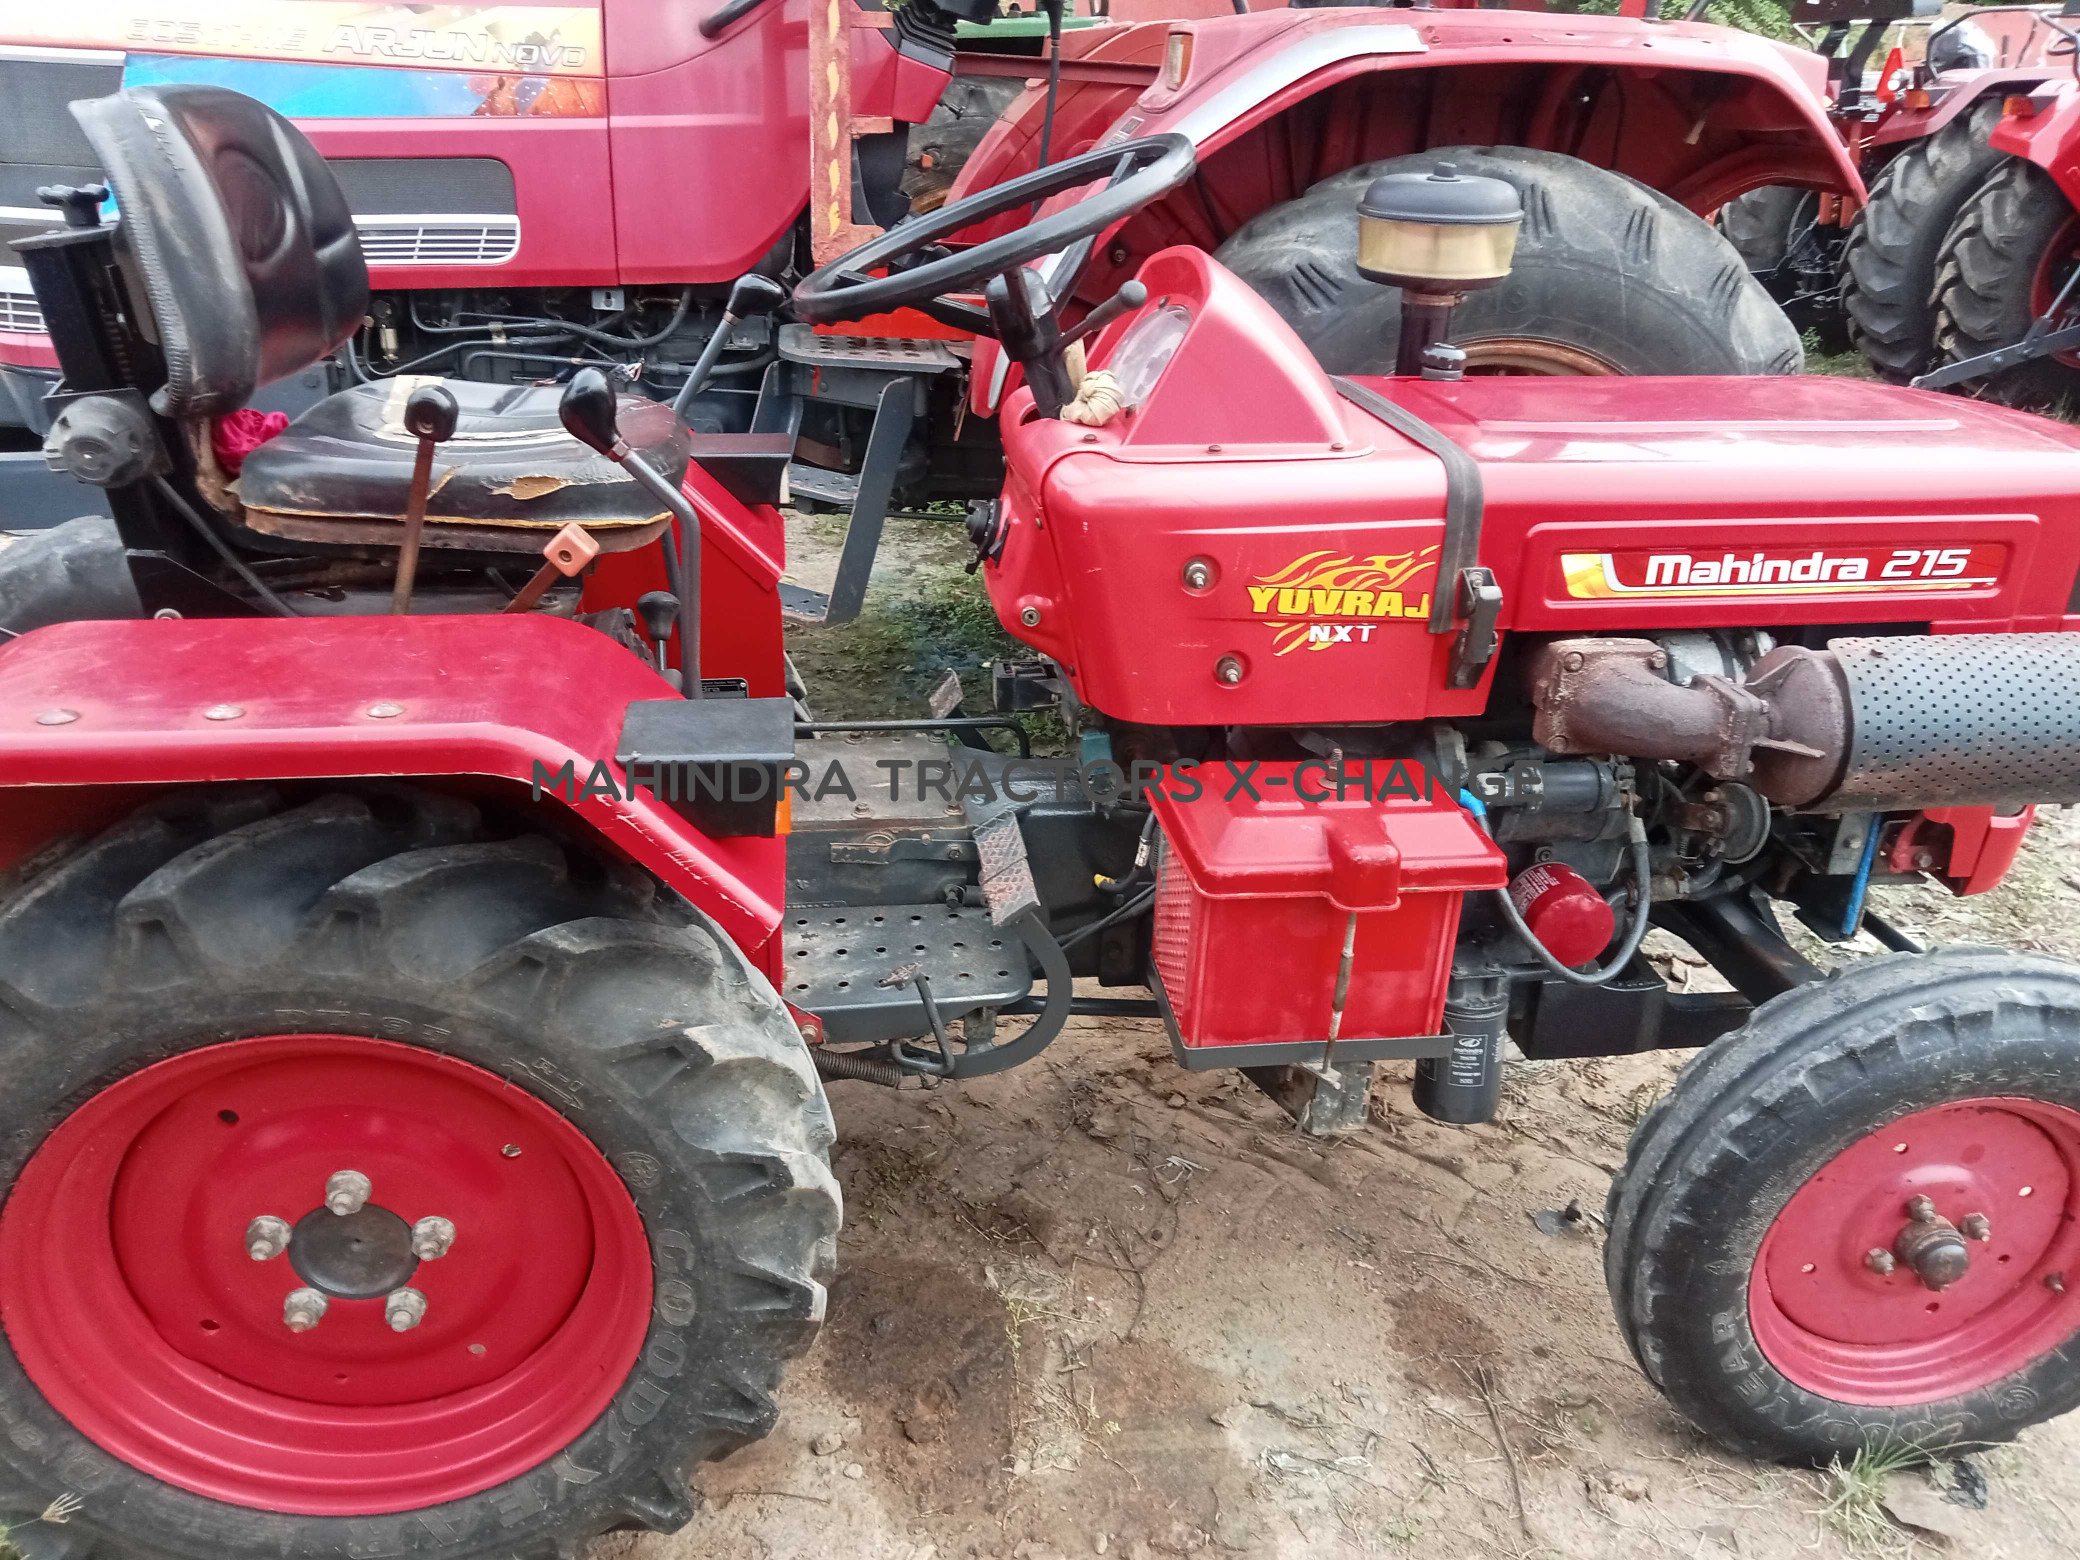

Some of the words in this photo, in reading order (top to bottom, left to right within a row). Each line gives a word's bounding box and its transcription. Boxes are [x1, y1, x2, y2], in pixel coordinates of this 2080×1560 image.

[321, 24, 488, 62] ARJUN
[491, 41, 586, 68] NOVO
[1645, 552, 1868, 585] Mahindra
[1880, 549, 1971, 578] 215
[1246, 586, 1430, 618] YUVRAJ
[1308, 624, 1377, 643] NXT
